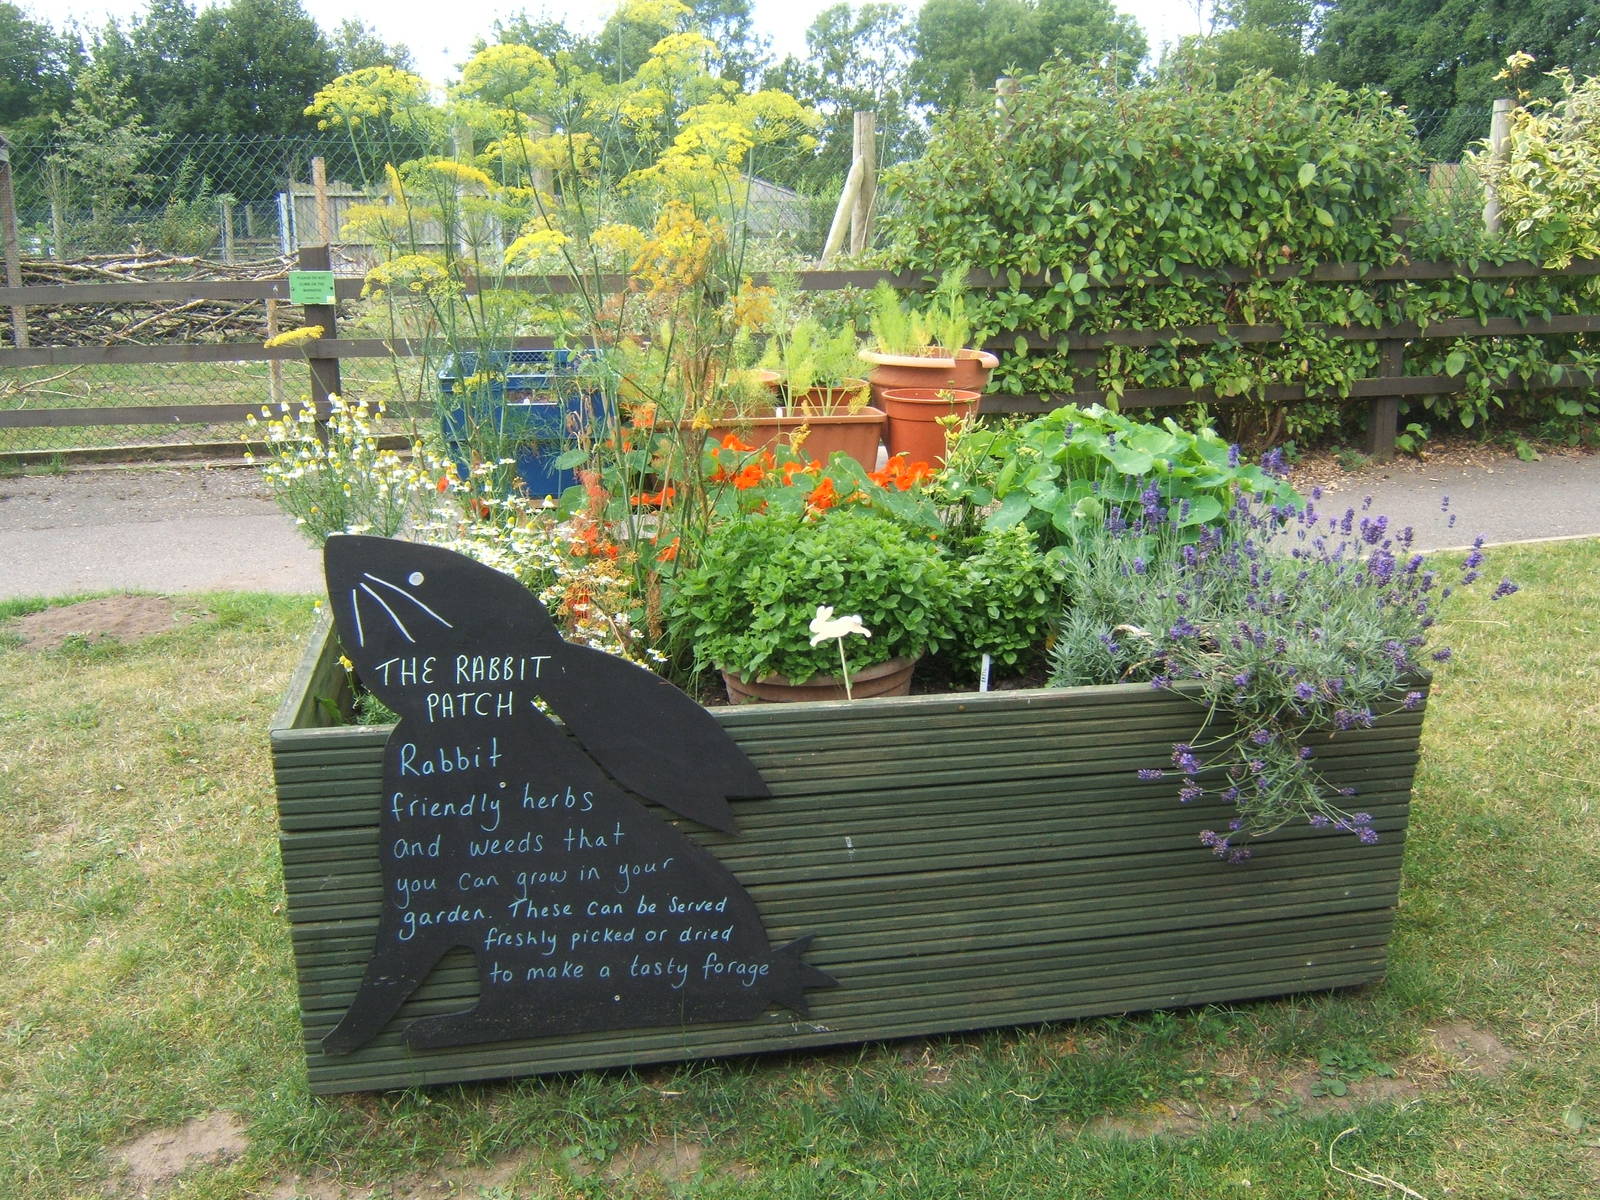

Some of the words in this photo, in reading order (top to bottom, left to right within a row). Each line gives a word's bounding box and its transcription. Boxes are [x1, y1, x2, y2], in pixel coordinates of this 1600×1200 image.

[374, 656, 437, 687] THE
[454, 654, 552, 685] RABBIT
[425, 690, 513, 723] PATCH
[399, 736, 502, 777] Rabbit
[391, 792, 501, 832] friendly
[522, 782, 593, 812] herbs
[394, 835, 441, 858] and
[469, 828, 543, 857] weeds
[563, 821, 625, 850] that
[394, 878, 437, 910] you
[514, 871, 567, 900] grow
[580, 867, 600, 881] in
[618, 857, 673, 894] your
[398, 905, 492, 941] garden.
[507, 895, 573, 919] These
[636, 895, 657, 915] be
[483, 927, 557, 956] freshly
[571, 927, 635, 951] picked
[644, 929, 668, 942] or
[679, 924, 734, 943] dried
[489, 961, 513, 984] to
[526, 960, 584, 981] make
[599, 965, 610, 978] a
[630, 955, 688, 990] tasty
[702, 952, 769, 987] forage
